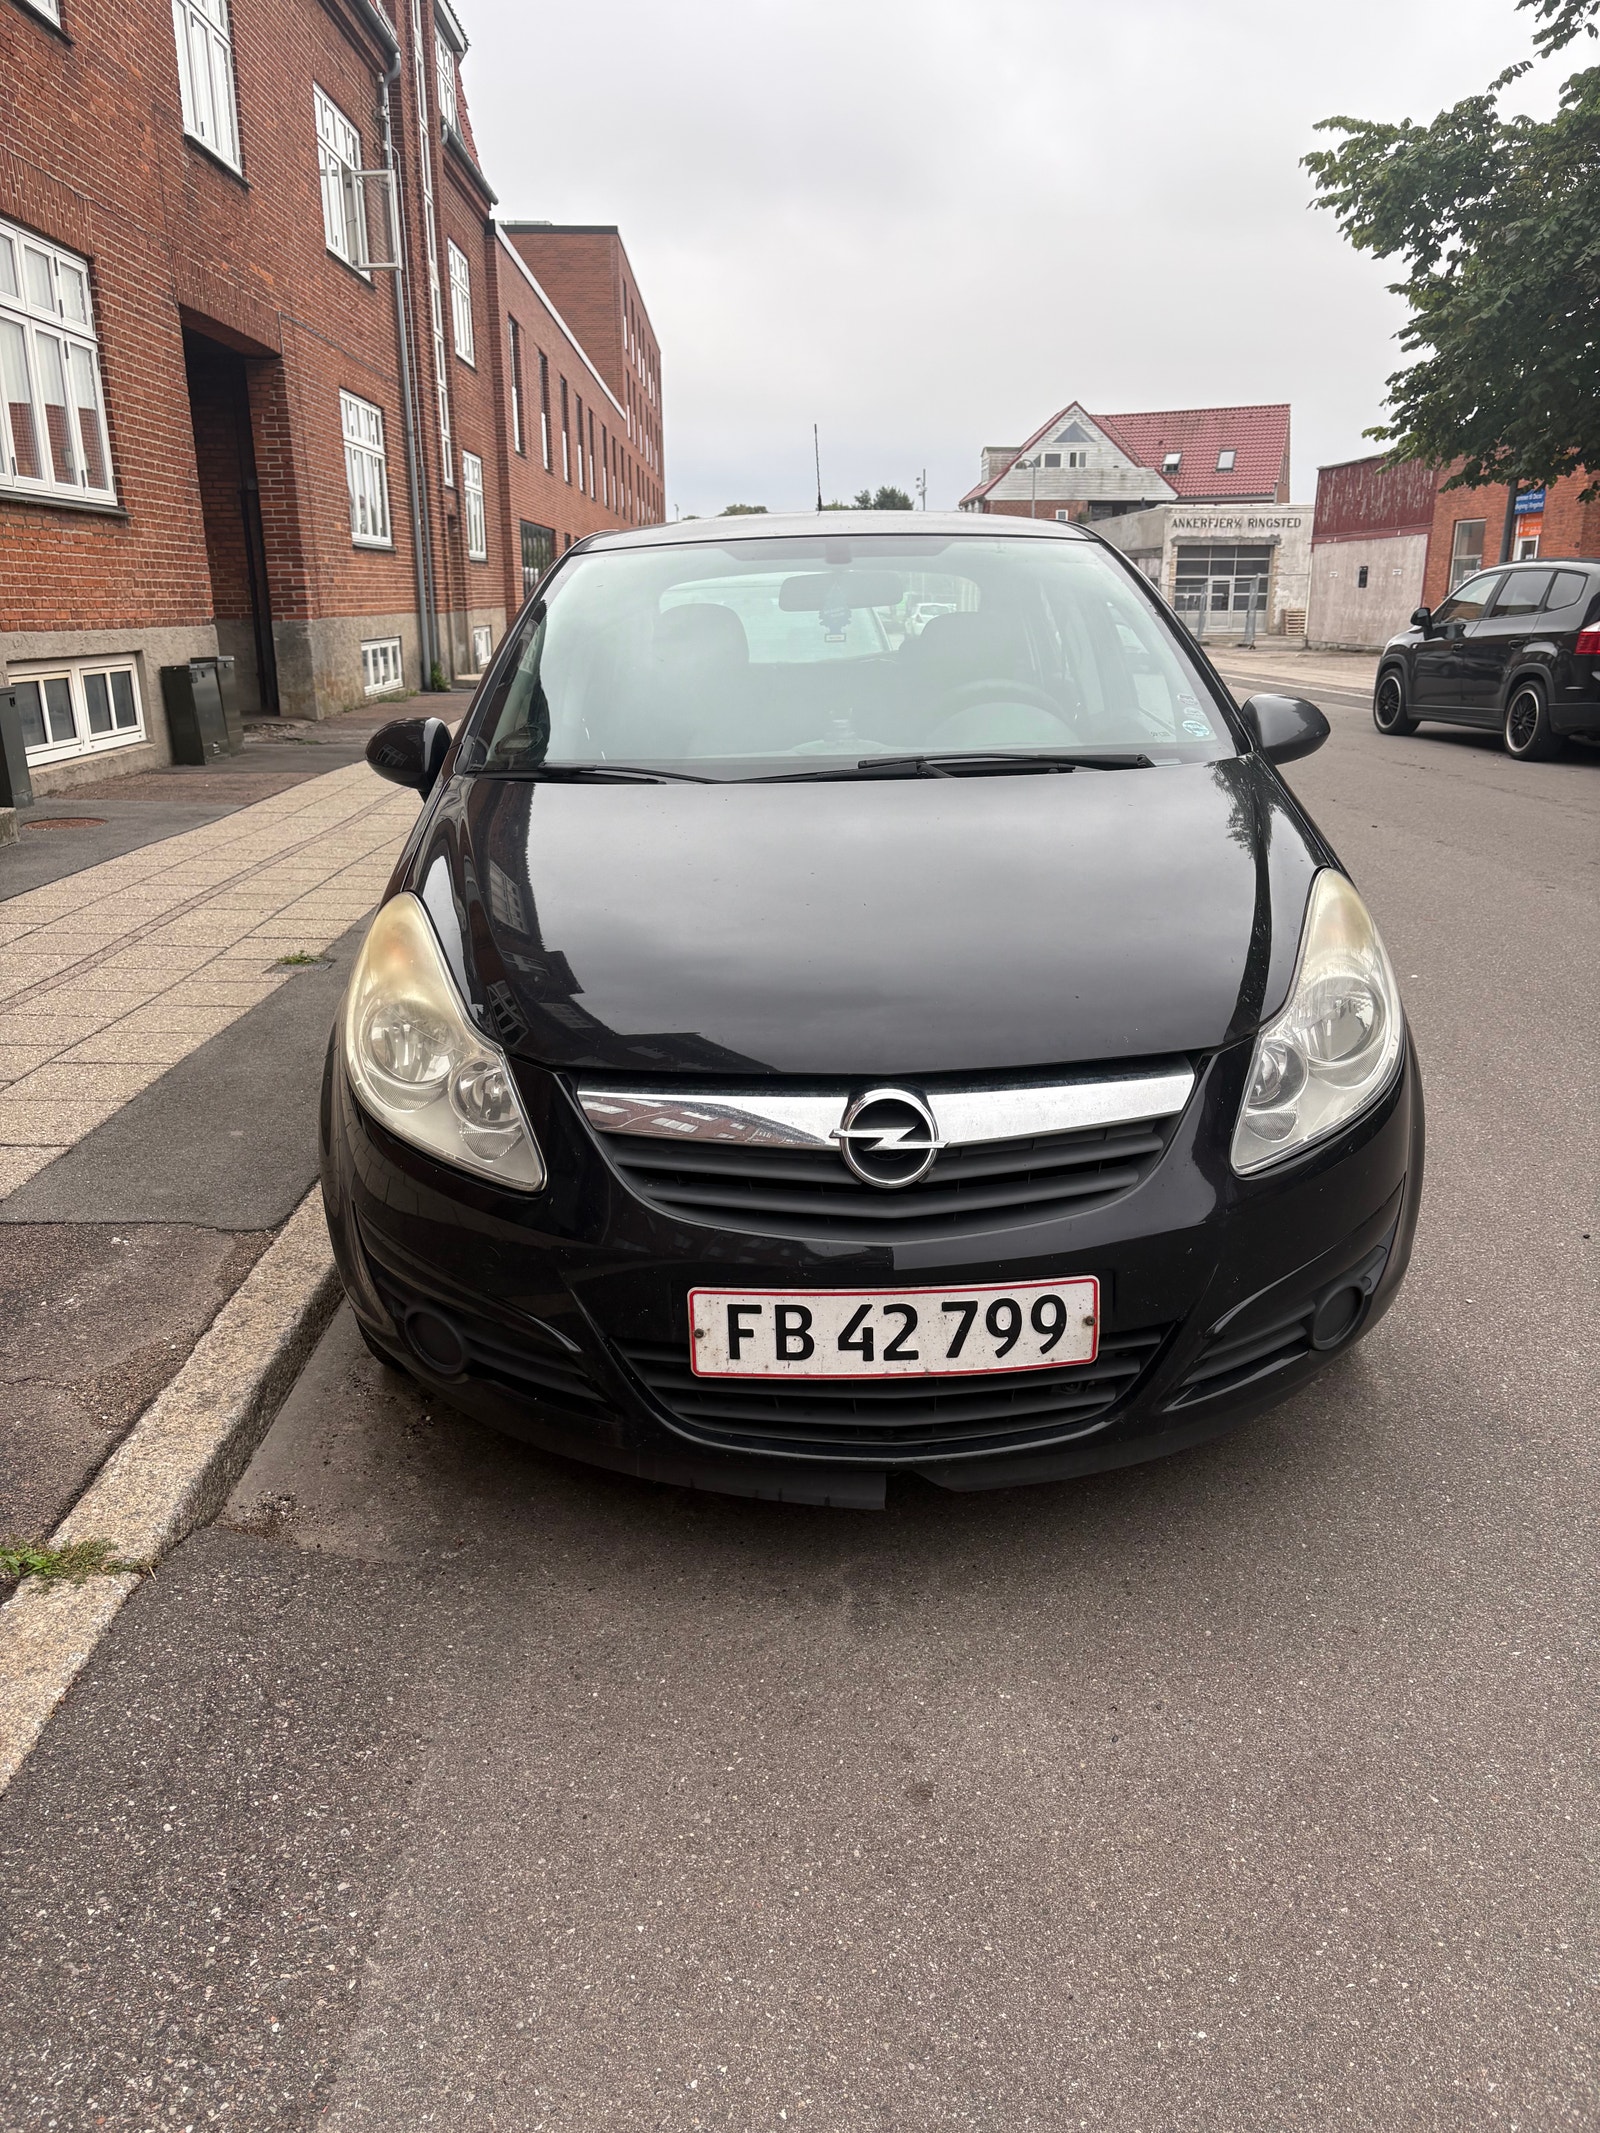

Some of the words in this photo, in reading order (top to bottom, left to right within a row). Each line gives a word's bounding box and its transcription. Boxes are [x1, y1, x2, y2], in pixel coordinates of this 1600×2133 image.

[1247, 517, 1302, 529] RINGSTED
[726, 1303, 816, 1361] FB
[837, 1302, 920, 1362] 42
[941, 1293, 1068, 1359] 799
